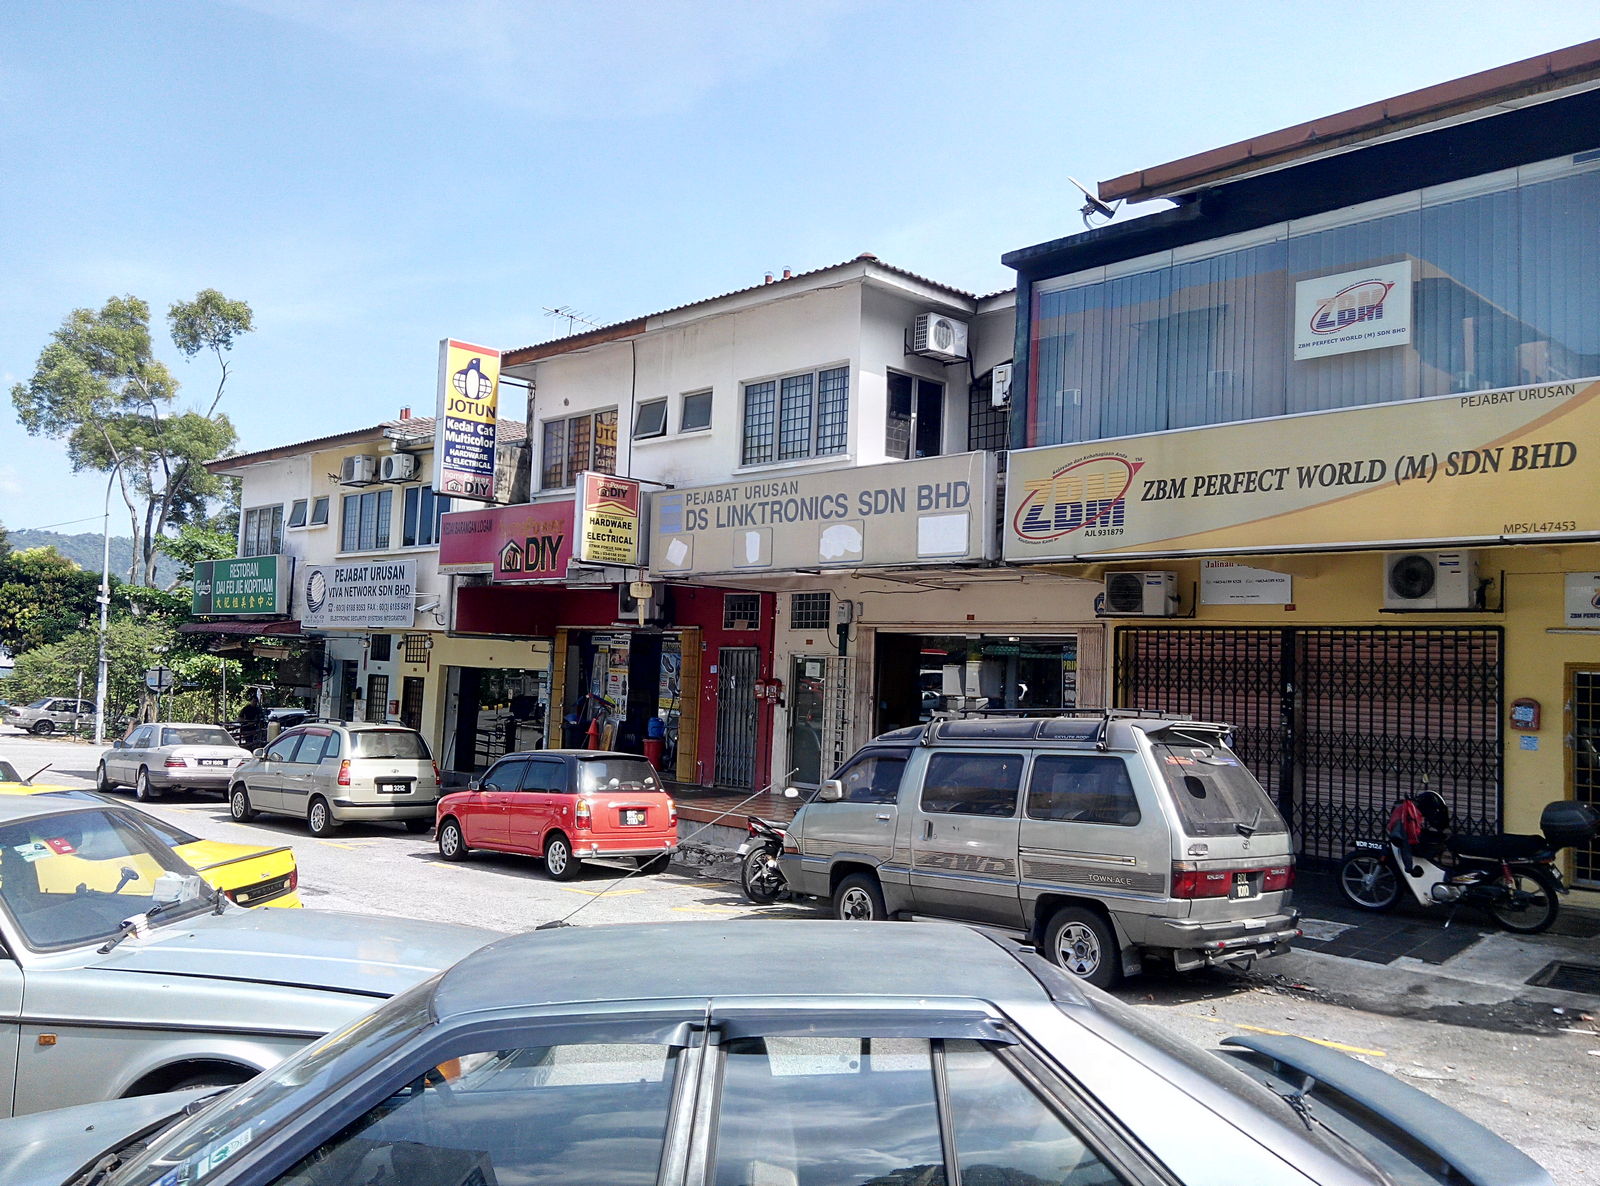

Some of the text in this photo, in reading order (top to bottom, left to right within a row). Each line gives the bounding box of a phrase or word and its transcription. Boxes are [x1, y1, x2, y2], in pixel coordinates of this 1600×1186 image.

[1312, 338, 1339, 347] PERFECT
[1340, 334, 1363, 342] WORLD
[1364, 332, 1375, 340] (M)
[1460, 384, 1576, 408] PEJABAT URUSAN
[448, 398, 496, 418] JOTUN
[447, 419, 494, 436] Kedai Cat
[446, 431, 494, 448] Multicolor
[449, 448, 488, 460] HARDWARE
[453, 457, 492, 469] ELECTRICAL
[1141, 440, 1577, 502] ZBM PERFECT WORLD (M) SDN BHD
[464, 481, 490, 496] DIY
[610, 487, 628, 498] DIY
[686, 480, 799, 505] PEJABAT URUSAN
[686, 481, 970, 531] DS LINKTRONICS SDN BHD
[589, 517, 632, 530] HARDWARE
[1503, 520, 1577, 535] MPS/L47453
[587, 532, 633, 545] ELECTRICAL
[1098, 528, 1124, 537] 931879
[524, 534, 564, 572] DIY
[229, 562, 259, 579] RESTORAN
[335, 565, 405, 583] PEJABAT URUSAN
[215, 580, 226, 595] DAI
[226, 580, 234, 594] FEI
[244, 578, 274, 594] KOPITIAM
[328, 584, 411, 598] VIVA NETWORK SDN BHD
[367, 603, 376, 611] FAX
[1237, 884, 1250, 897] 1010
